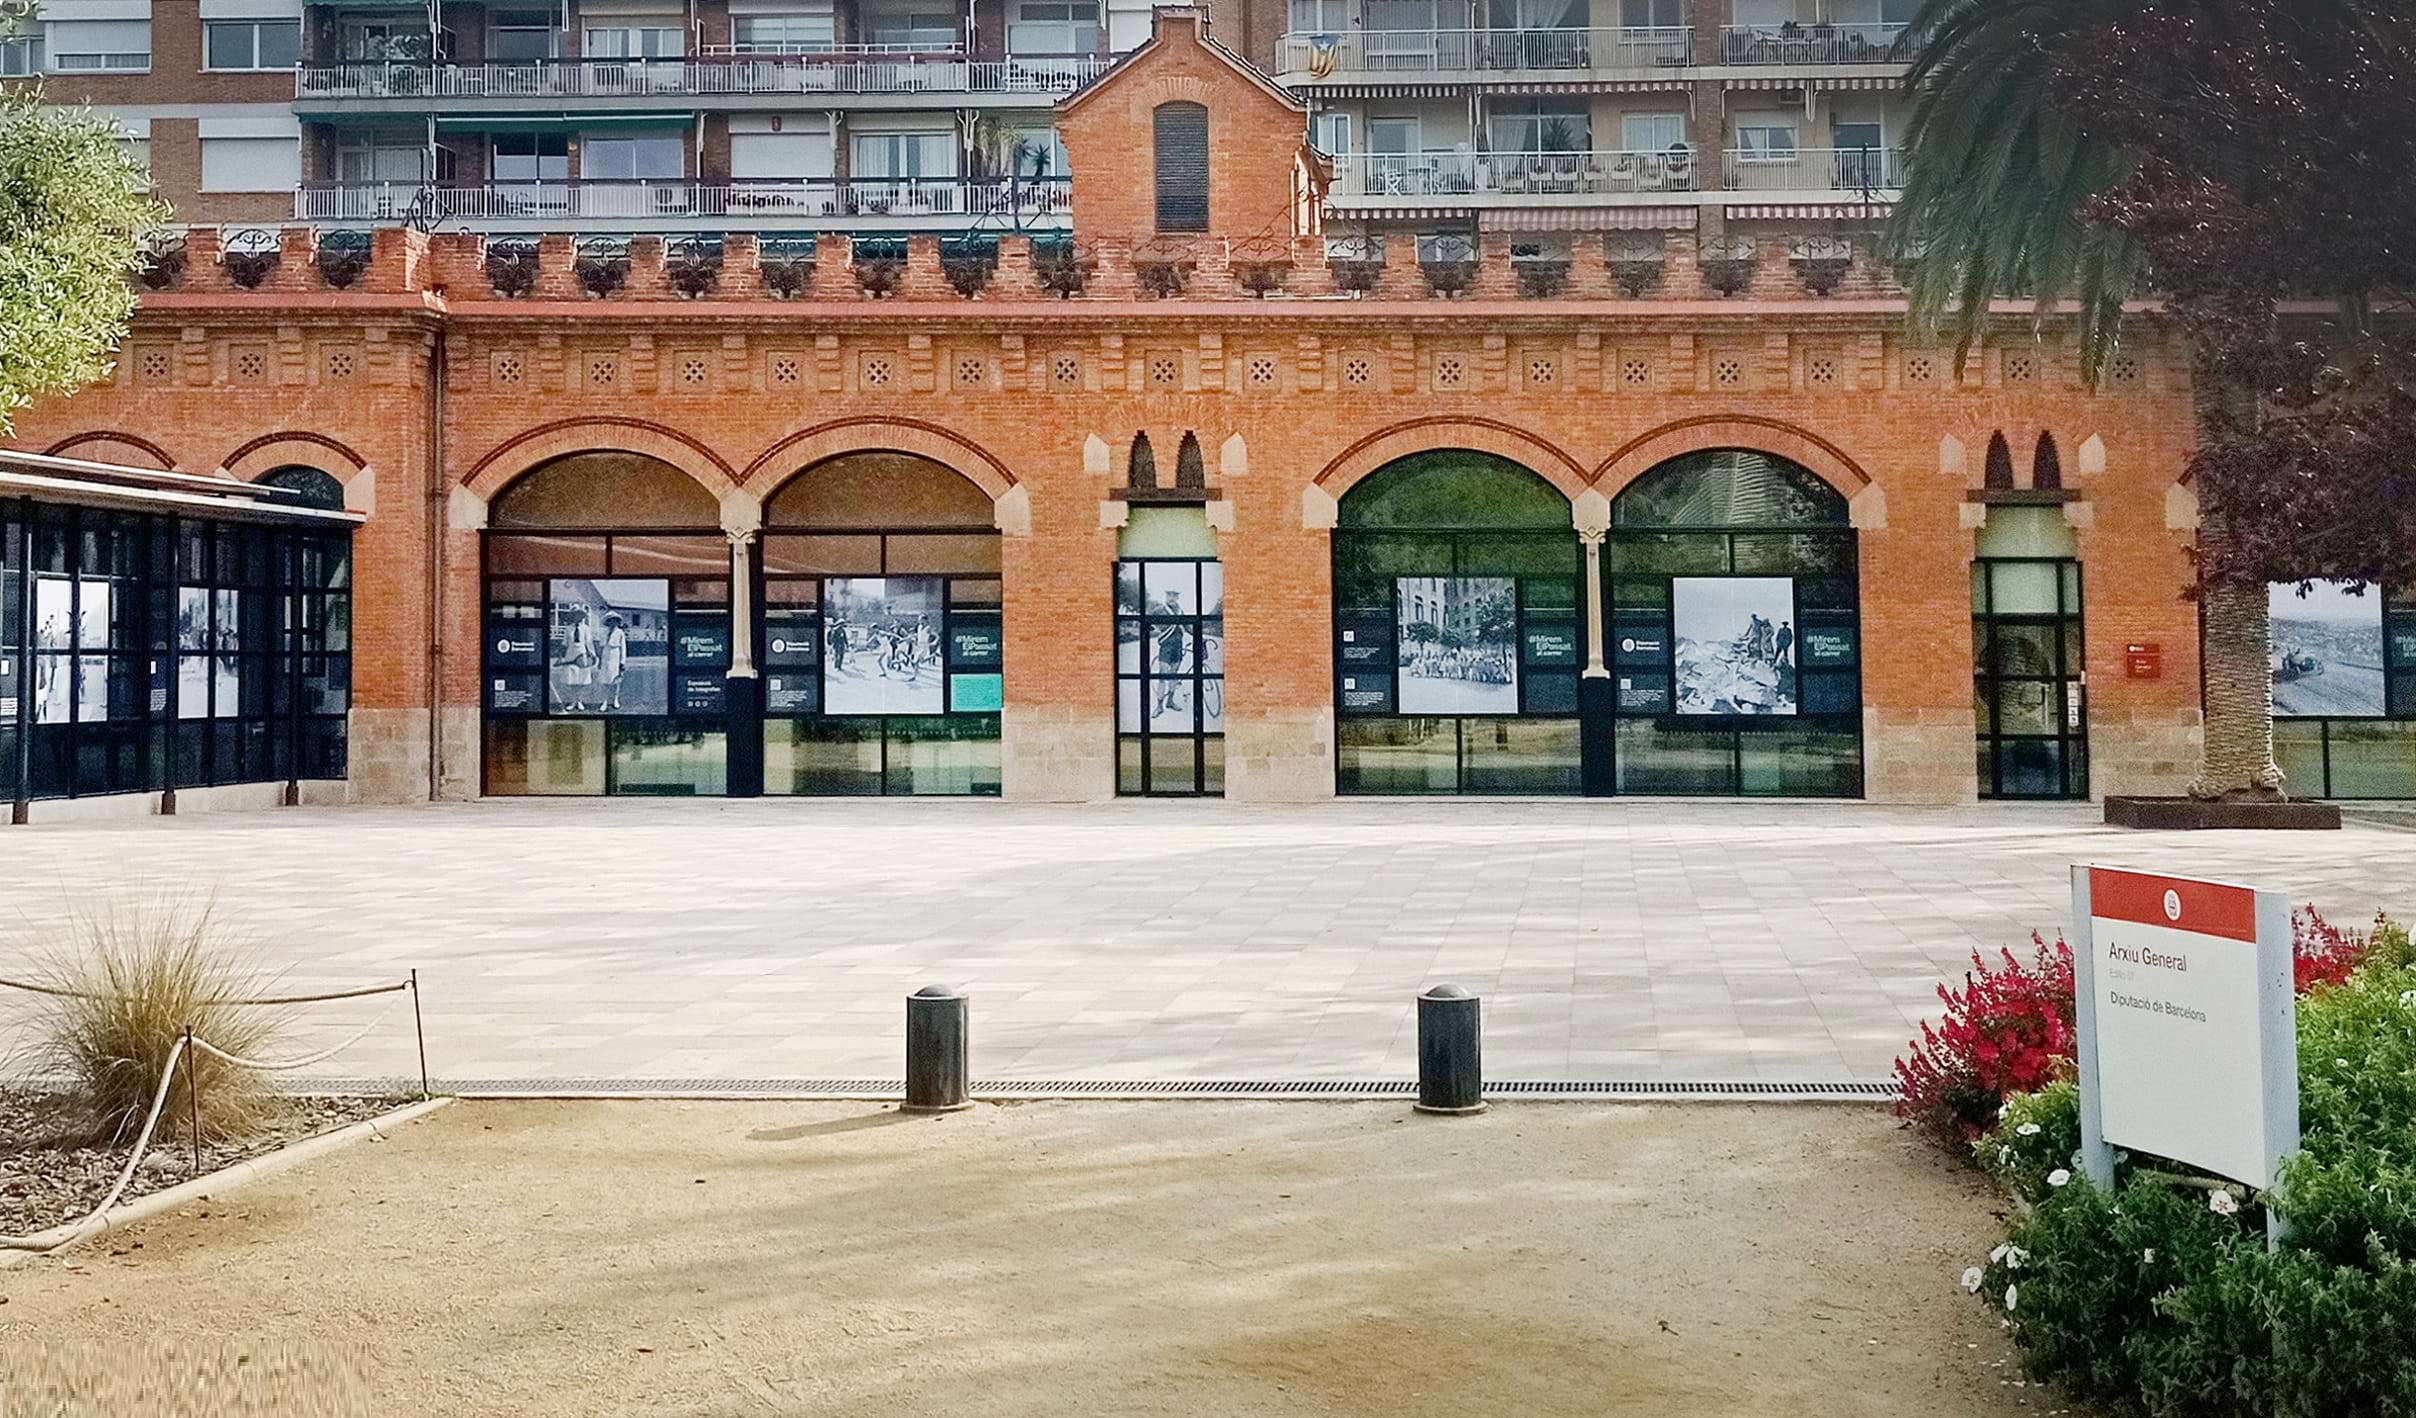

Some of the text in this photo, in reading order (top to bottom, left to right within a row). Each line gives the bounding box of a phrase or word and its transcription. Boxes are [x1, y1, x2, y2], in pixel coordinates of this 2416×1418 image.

[2109, 941, 2187, 972] Arxiu General
[2110, 990, 2207, 1023] Diputació de Barcelona
